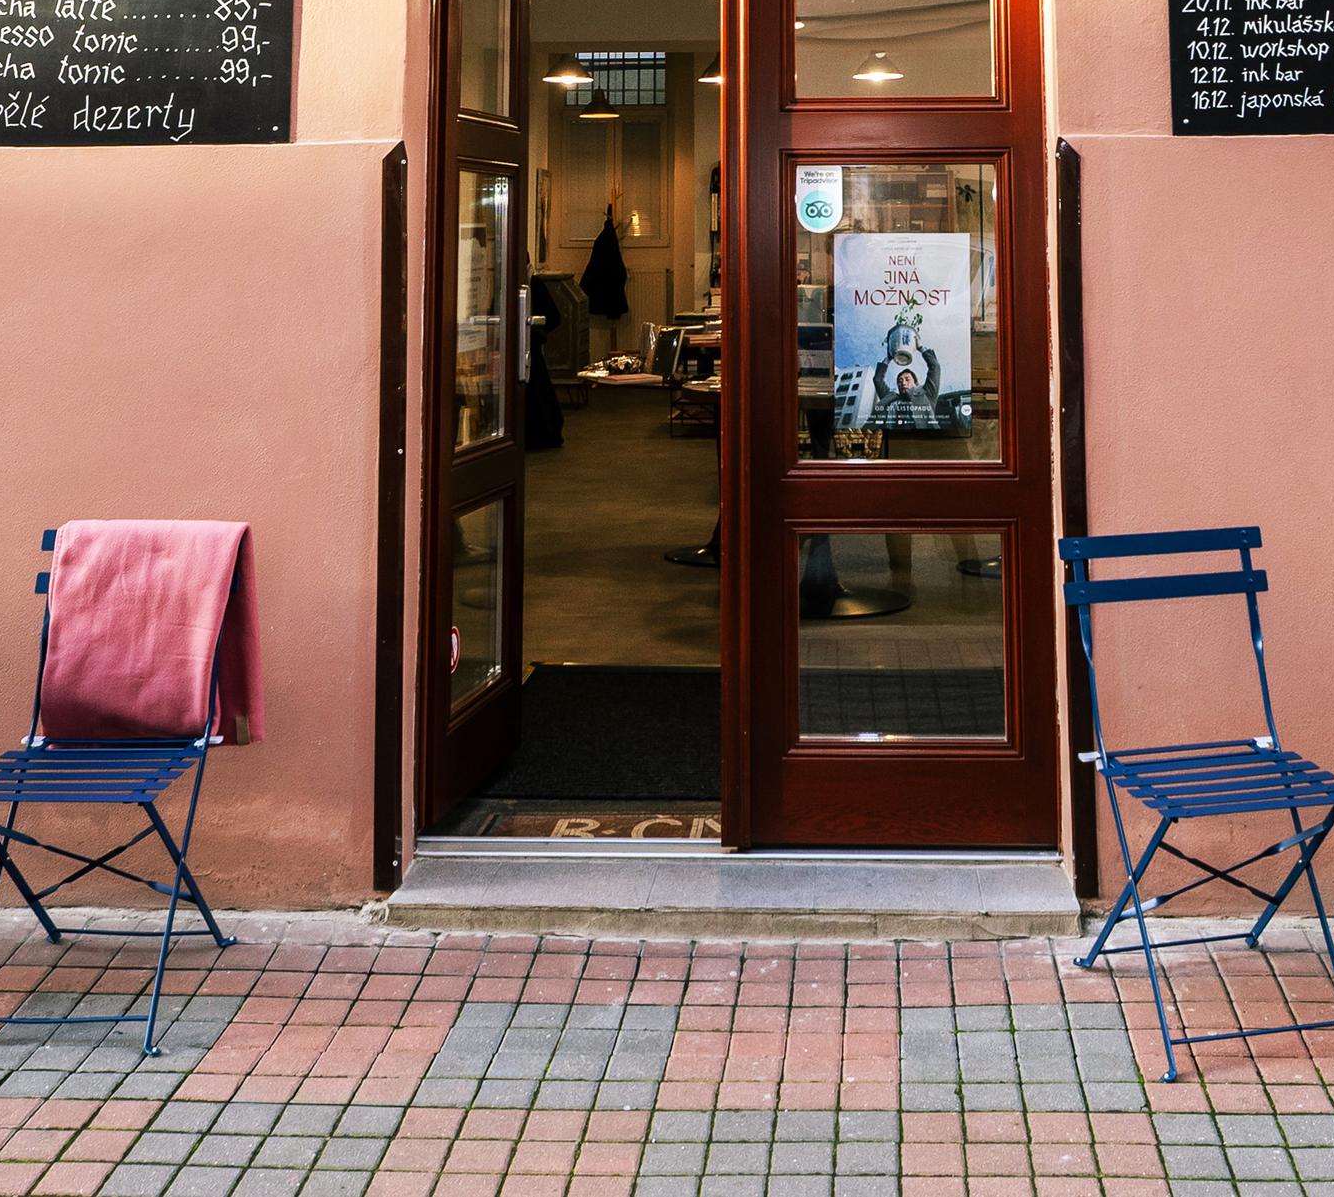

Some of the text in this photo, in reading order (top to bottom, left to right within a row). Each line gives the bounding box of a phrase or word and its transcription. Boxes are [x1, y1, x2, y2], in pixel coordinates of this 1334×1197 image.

[1196, 17, 1235, 37] 4.12.
[71, 24, 139, 54] tonic
[1186, 41, 1234, 61] 10.12.
[1239, 38, 1330, 62] workshop
[57, 55, 127, 85] tonic
[1189, 62, 1304, 85] 12.12. ink bar
[1191, 90, 1234, 111] 16.12.
[1236, 86, 1324, 119] japonská
[73, 92, 196, 142] dezerty
[888, 252, 917, 266] NENÍ
[883, 268, 921, 285] JINÁ
[854, 286, 951, 306] MOŽNOST
